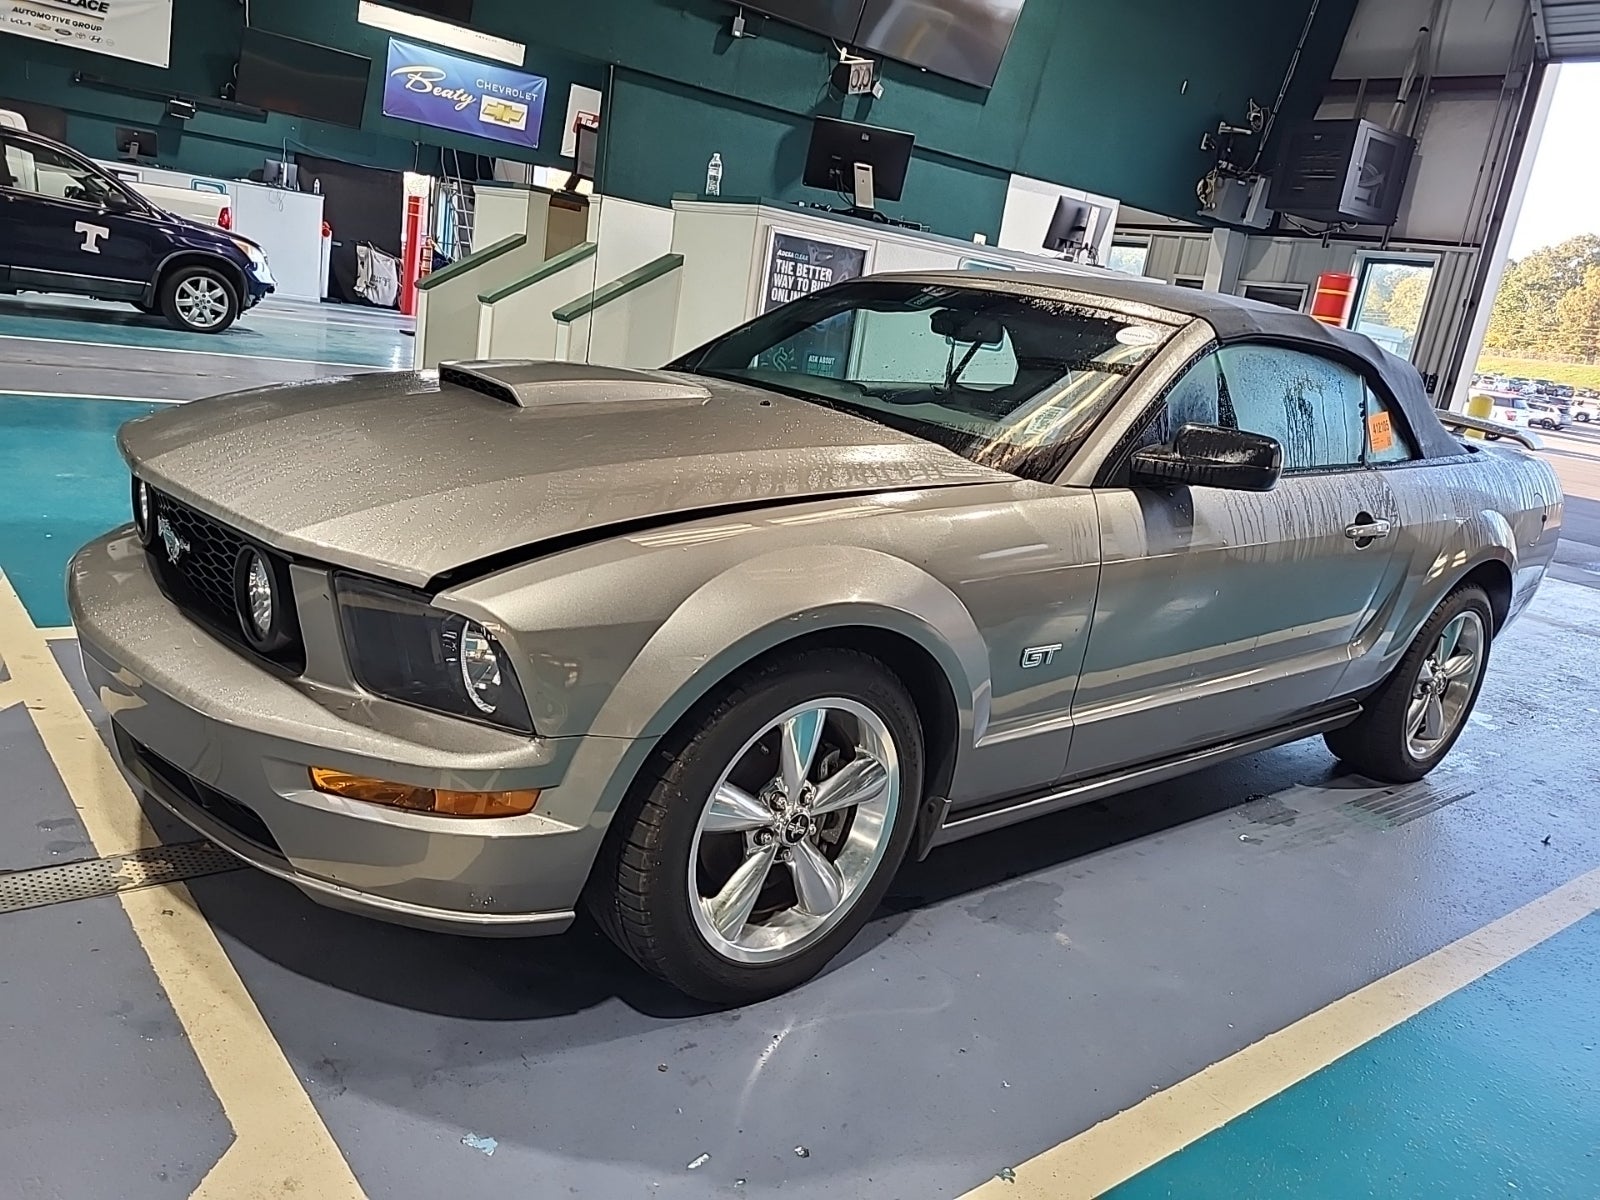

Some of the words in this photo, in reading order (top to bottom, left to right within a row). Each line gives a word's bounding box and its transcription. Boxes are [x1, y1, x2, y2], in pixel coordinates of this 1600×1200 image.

[12, 6, 71, 25] AUTOMOTIVE
[72, 20, 102, 31] GROUP
[390, 65, 477, 112] Beaty
[476, 78, 539, 102] CHEVROLET
[75, 221, 109, 253] T
[773, 272, 796, 290] WAY
[796, 276, 810, 292] TO
[775, 258, 796, 275] THE
[795, 262, 833, 283] BETTER
[819, 356, 835, 365] ABOUT
[1022, 643, 1063, 669] GT
